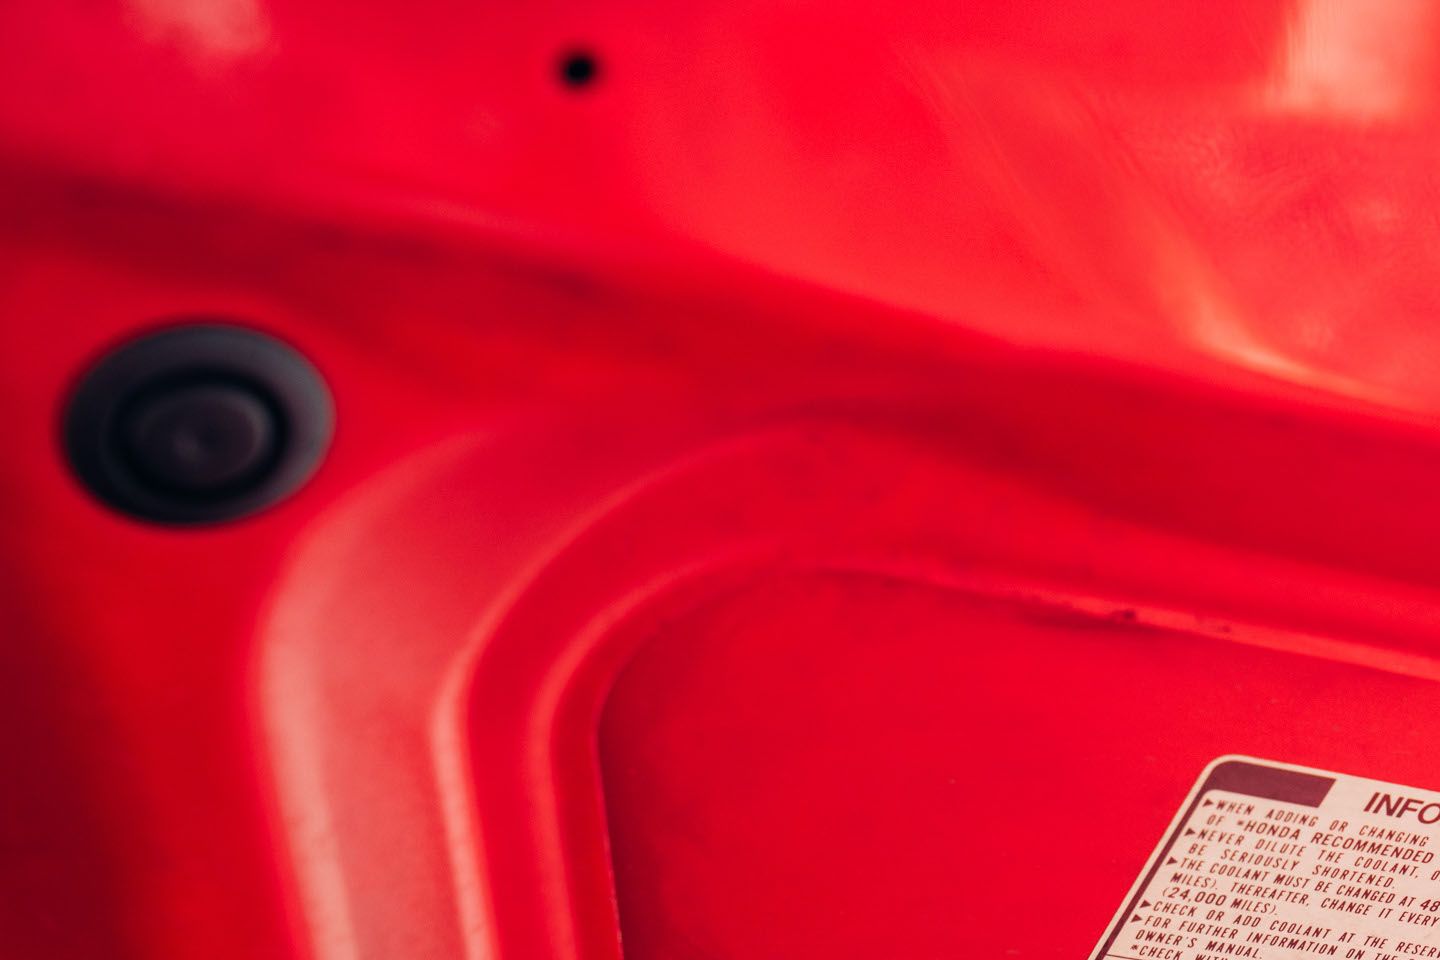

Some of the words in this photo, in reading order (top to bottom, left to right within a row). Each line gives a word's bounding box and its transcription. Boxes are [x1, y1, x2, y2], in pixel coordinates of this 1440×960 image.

[1196, 828, 1245, 846] NEVER
[1253, 837, 1306, 857] DILUTE
[1316, 848, 1344, 864] THE
[1205, 813, 1225, 826] OF
[1309, 830, 1435, 864] RECOMMENDED
[1215, 799, 1255, 815] WHEN
[1264, 808, 1319, 827] ADDING
[1328, 818, 1349, 832] OR
[1357, 824, 1430, 847] CHANGING
[1179, 856, 1204, 871] THE
[1208, 861, 1270, 882] COOLANT
[1272, 873, 1311, 889] MUST
[1313, 879, 1332, 893] BE
[1335, 883, 1396, 904] CHANGED
[1397, 895, 1417, 907] AT
[1187, 842, 1207, 856] BE
[1219, 847, 1300, 871] SERIOUSLY
[1310, 863, 1395, 889] SHORTENED.
[1161, 885, 1227, 907] (24,000
[1319, 896, 1372, 916] CHANGE
[1377, 906, 1393, 919] IT
[1397, 910, 1440, 927] EVERY
[1134, 928, 1198, 949] OWNER'S
[1204, 939, 1262, 960] MANUAL.
[1143, 914, 1172, 929] FOR
[1177, 919, 1239, 939] FURTHER
[1245, 930, 1338, 956] INFORMATION
[1344, 947, 1366, 960] ON
[1152, 900, 1198, 917] CHECK
[1204, 908, 1225, 922] OR
[1232, 913, 1262, 928] ADD
[1268, 918, 1332, 939] COOLANT
[1337, 930, 1356, 943] AT
[1362, 934, 1388, 949] THE
